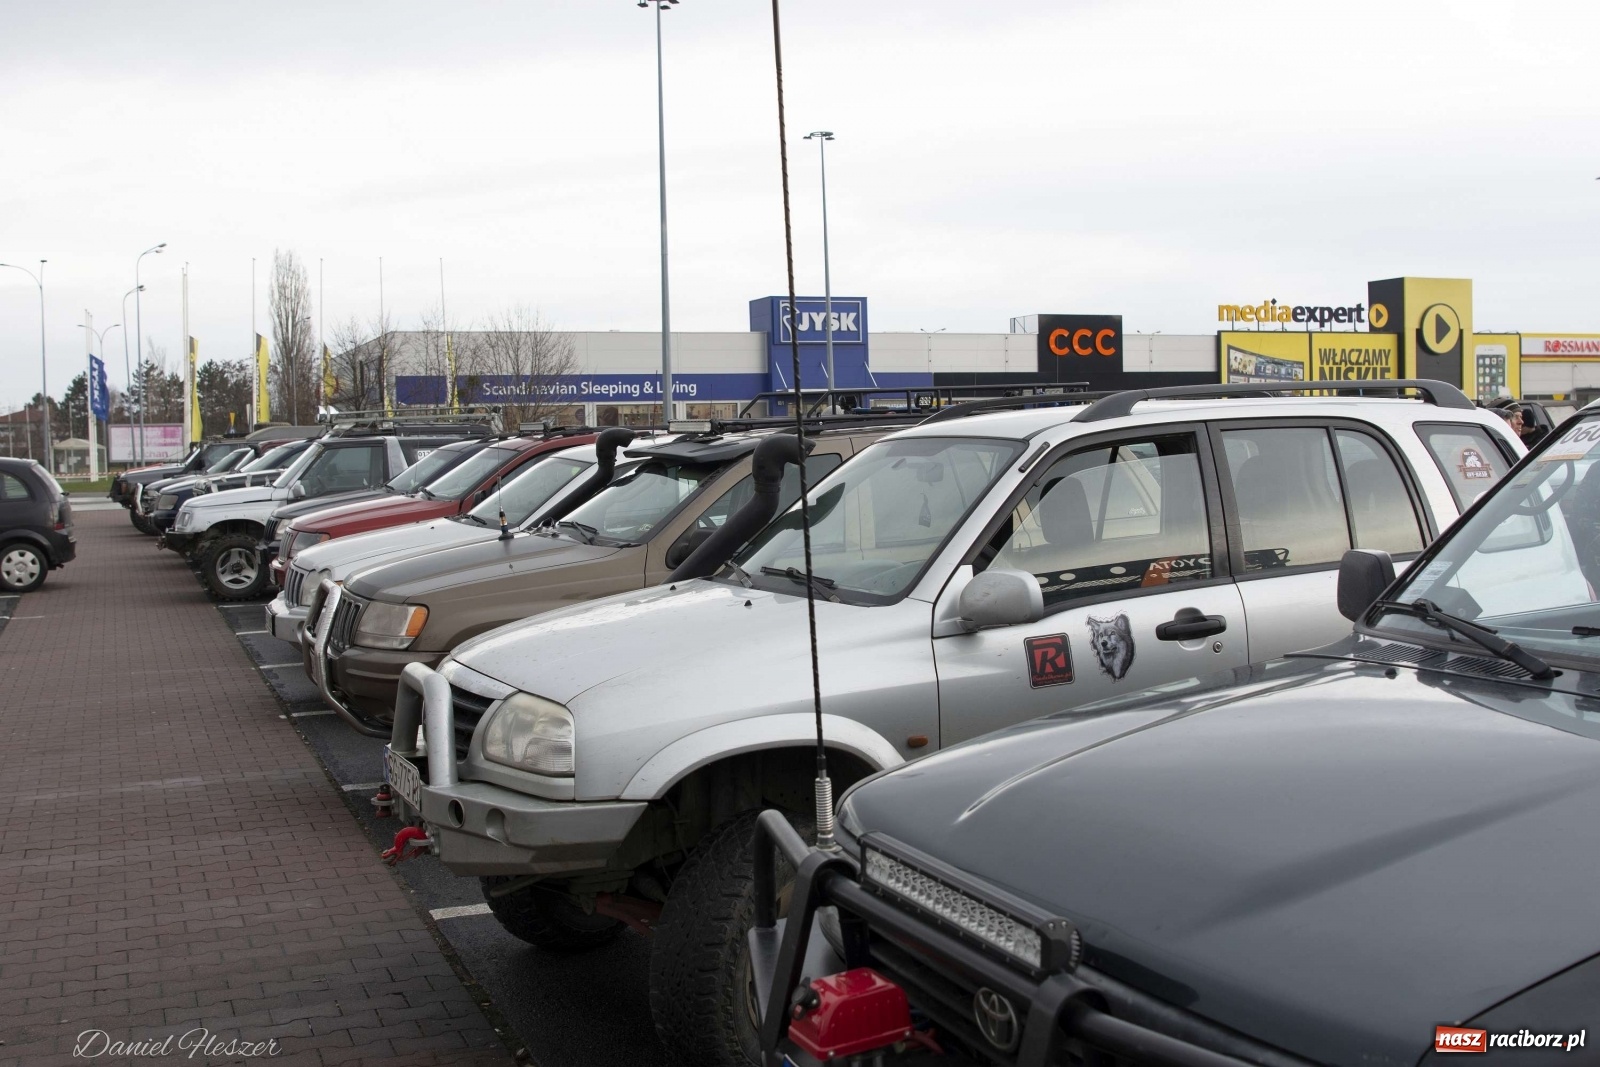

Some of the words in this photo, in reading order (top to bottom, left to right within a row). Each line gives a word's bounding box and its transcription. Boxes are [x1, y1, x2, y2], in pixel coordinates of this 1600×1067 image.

[798, 312, 858, 331] JYSK
[1218, 298, 1365, 328] mediaexpert
[1049, 328, 1117, 356] CCC
[1318, 348, 1391, 367] WŁĄCZAMY
[580, 381, 640, 397] Sleeping
[643, 381, 654, 394] &
[656, 381, 697, 397] Lving
